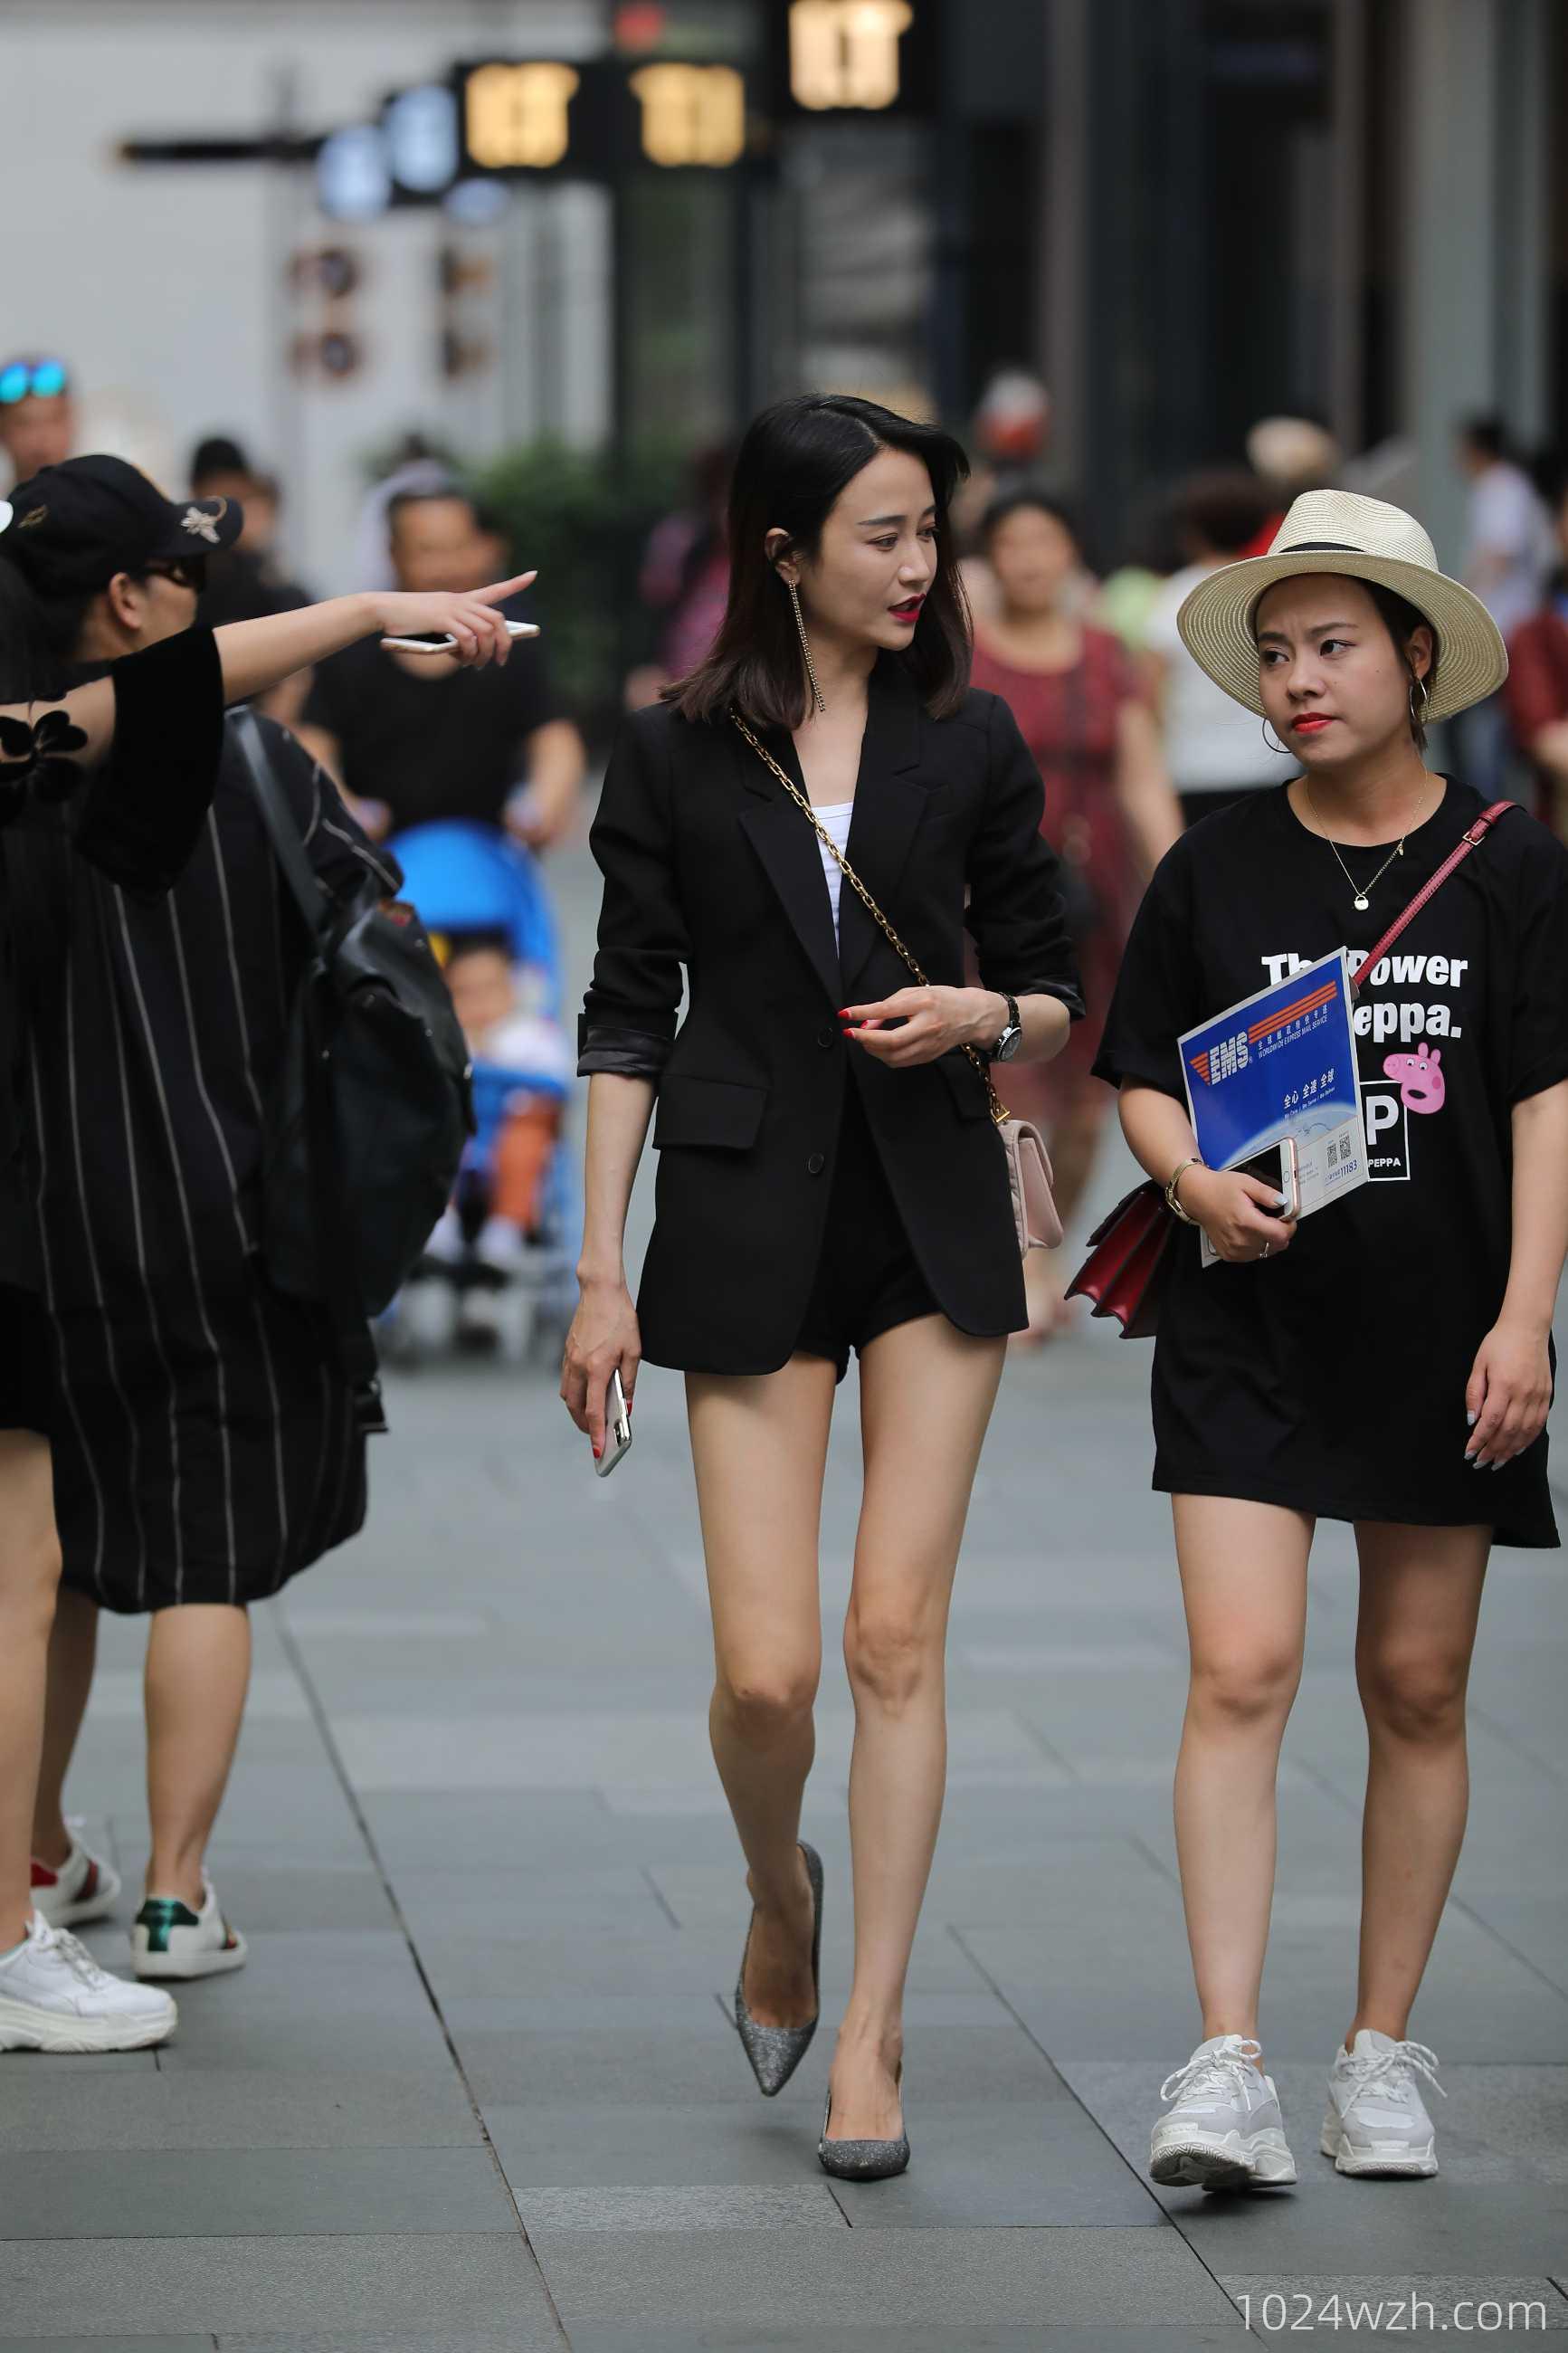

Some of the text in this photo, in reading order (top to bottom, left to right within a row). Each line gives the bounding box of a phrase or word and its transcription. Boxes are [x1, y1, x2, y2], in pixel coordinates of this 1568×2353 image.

[1261, 950, 1468, 987] Th Power
[1284, 1029, 1301, 1046] EXPRESS
[1312, 1015, 1328, 1030] SERVICE
[1353, 1002, 1462, 1043] eppa.
[1210, 1030, 1250, 1085] EMS
[1284, 1090, 1299, 1110] 全心
[1320, 1068, 1335, 1089] 全球
[1366, 1095, 1399, 1145] P
[1341, 1158, 1358, 1177] 11183
[1368, 1157, 1402, 1168] PEPPA
